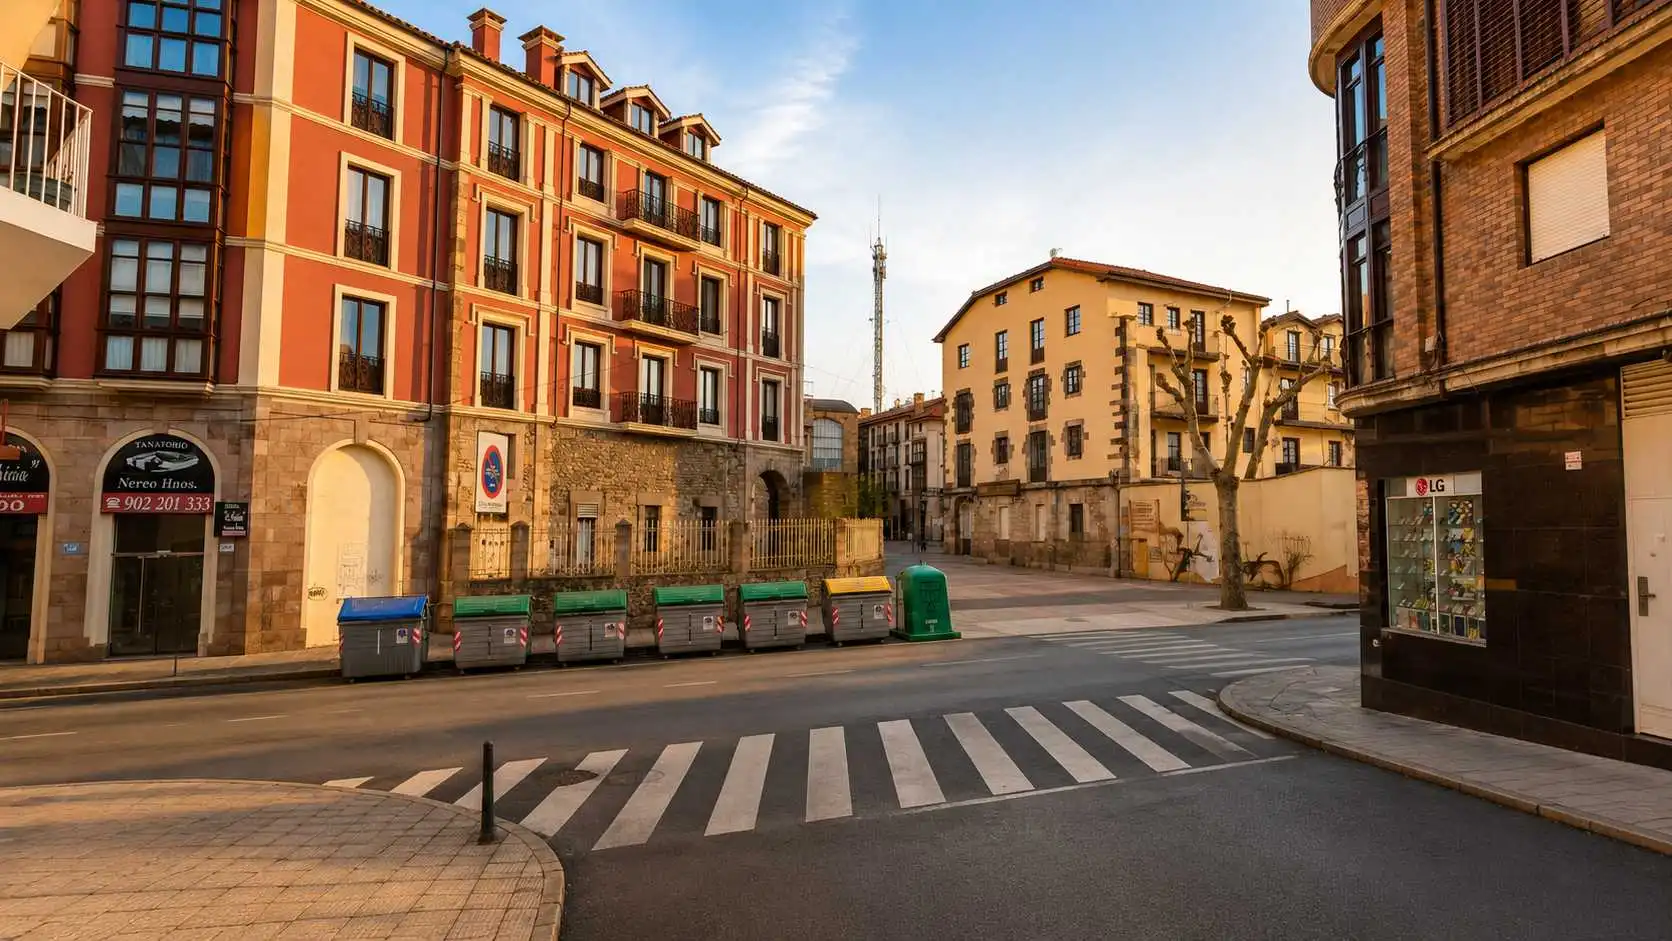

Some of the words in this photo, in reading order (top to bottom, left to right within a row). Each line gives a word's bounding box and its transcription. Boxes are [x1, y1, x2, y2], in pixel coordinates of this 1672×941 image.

[136, 440, 188, 449] TANATORIO
[118, 477, 157, 489] Nereo
[162, 477, 197, 489] Hnos.
[1429, 478, 1445, 493] LG
[123, 496, 152, 511] 902
[155, 496, 180, 511] 201
[185, 496, 210, 512] 333
